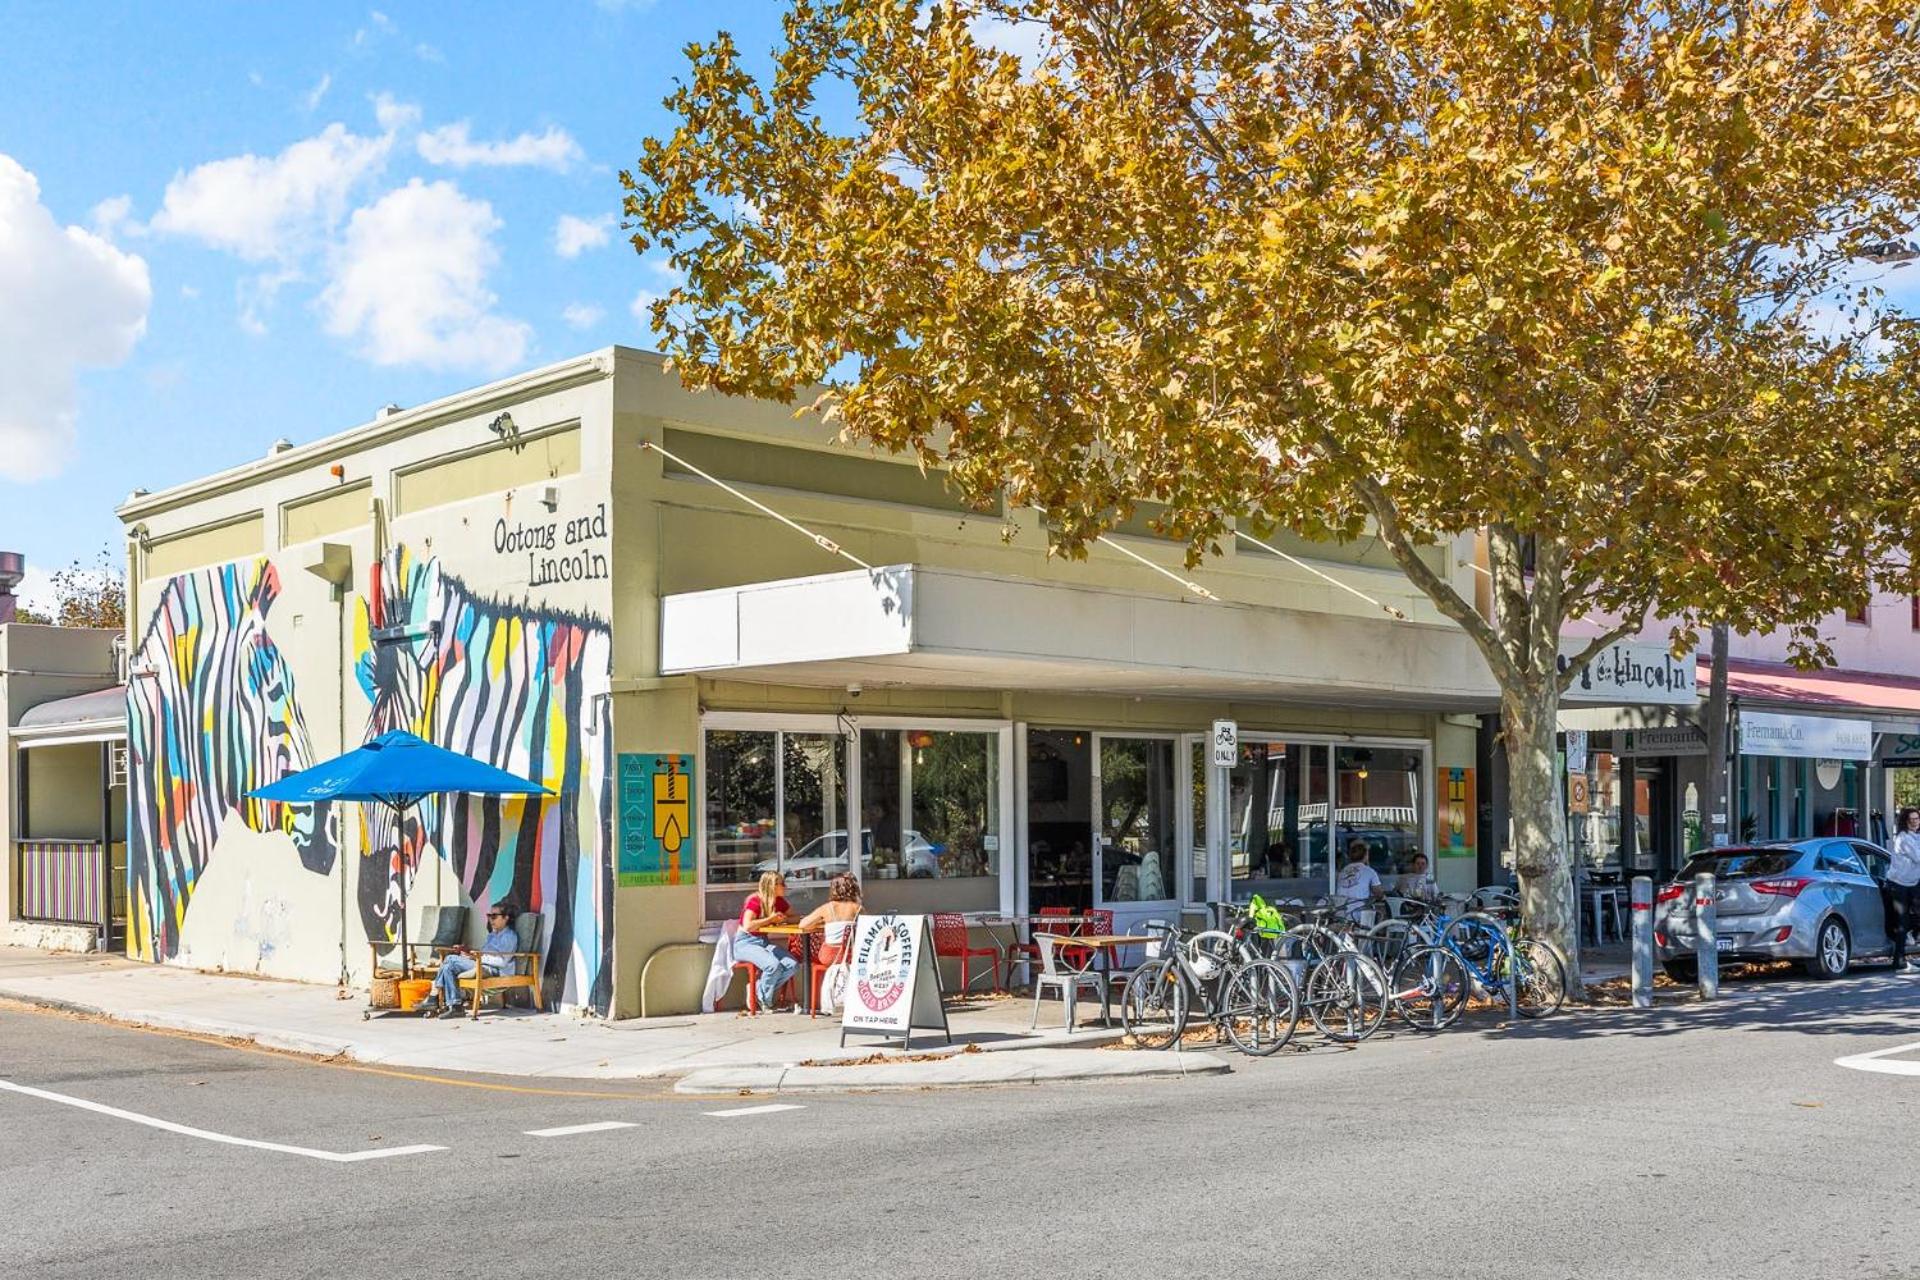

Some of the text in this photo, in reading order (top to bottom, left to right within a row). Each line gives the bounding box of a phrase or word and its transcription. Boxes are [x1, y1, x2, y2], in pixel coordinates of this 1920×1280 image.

[494, 503, 607, 554] Ootong and
[528, 548, 609, 587] Lincoln
[1613, 646, 1687, 693] Lincoln
[1215, 750, 1236, 761] ONLY
[858, 914, 912, 966] FILAMENT COFFEE
[853, 1015, 898, 1025] ON TAP HERE
